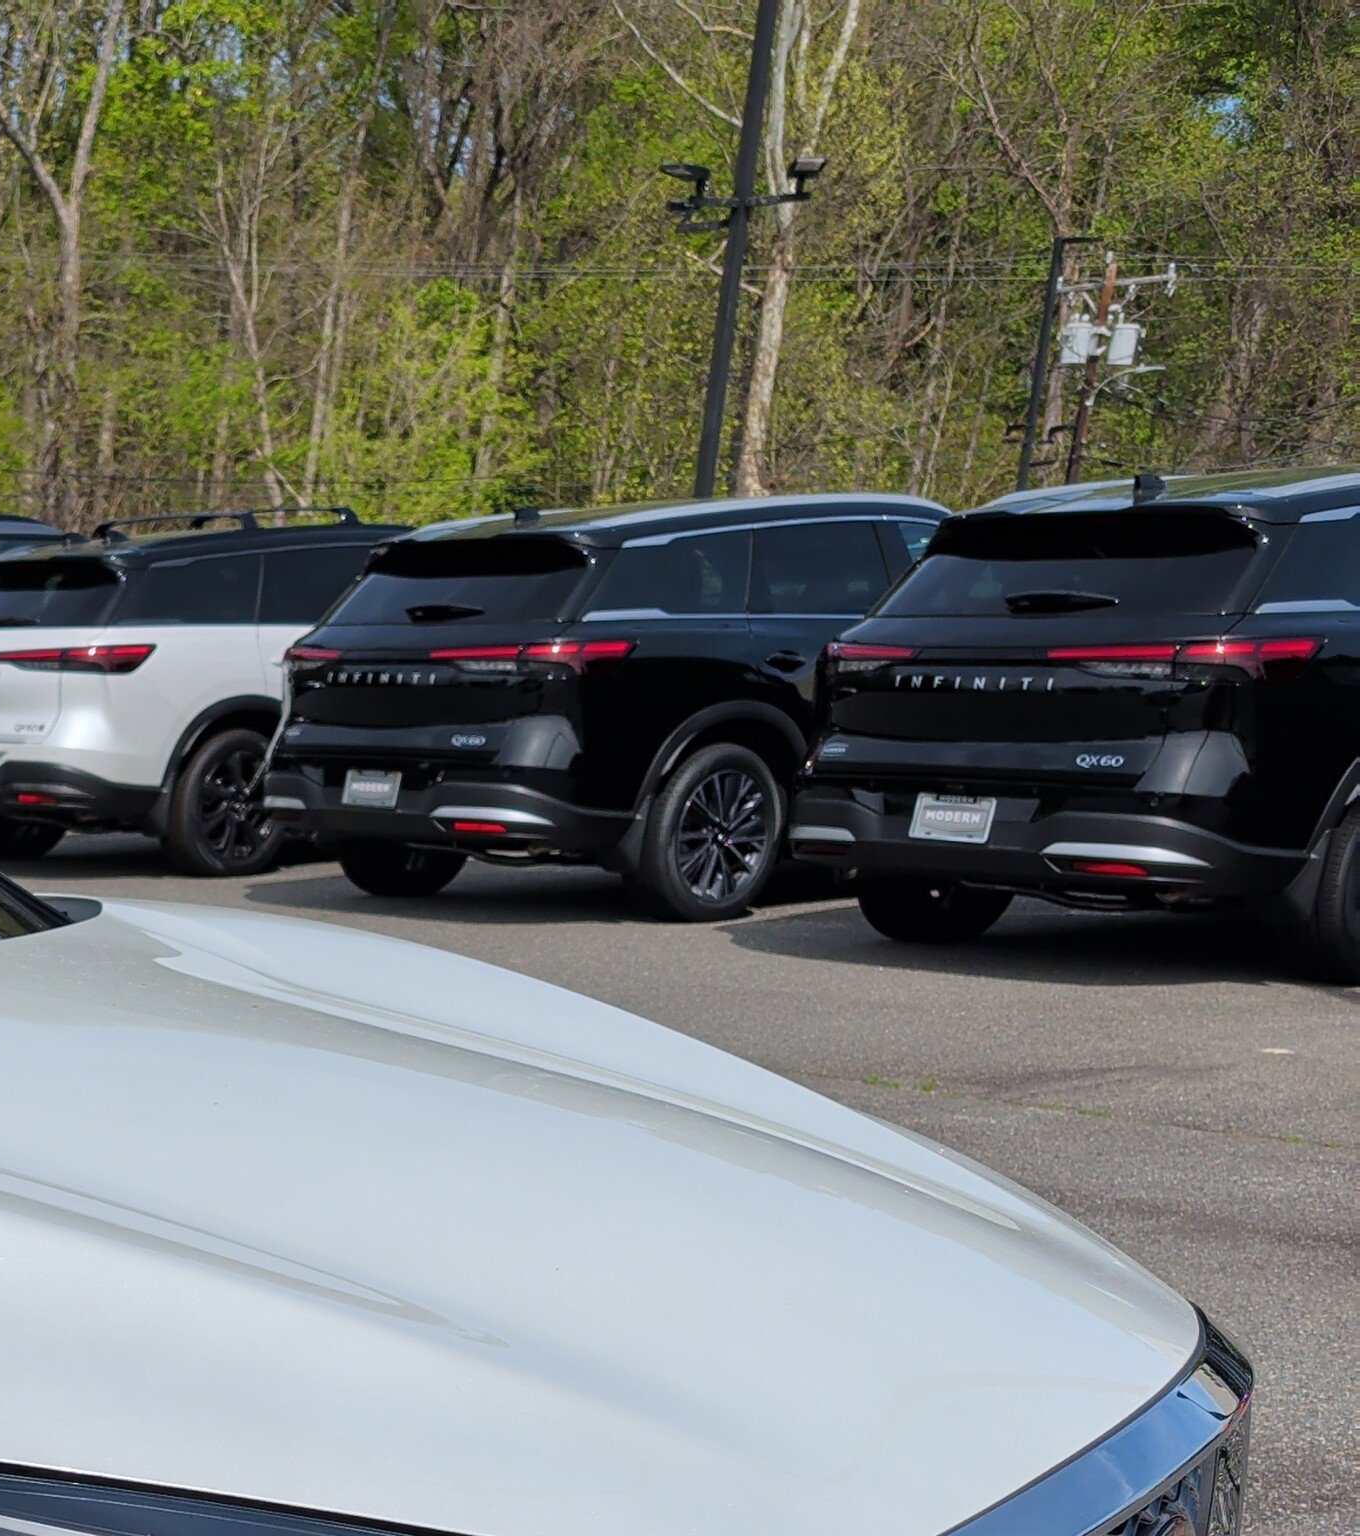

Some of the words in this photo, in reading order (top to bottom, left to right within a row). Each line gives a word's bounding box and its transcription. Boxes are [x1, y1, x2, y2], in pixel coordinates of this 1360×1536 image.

[327, 671, 437, 685] INFINITI
[895, 674, 1055, 691] INFINITI
[1075, 753, 1125, 769] QX60
[924, 809, 982, 824] MODERN
